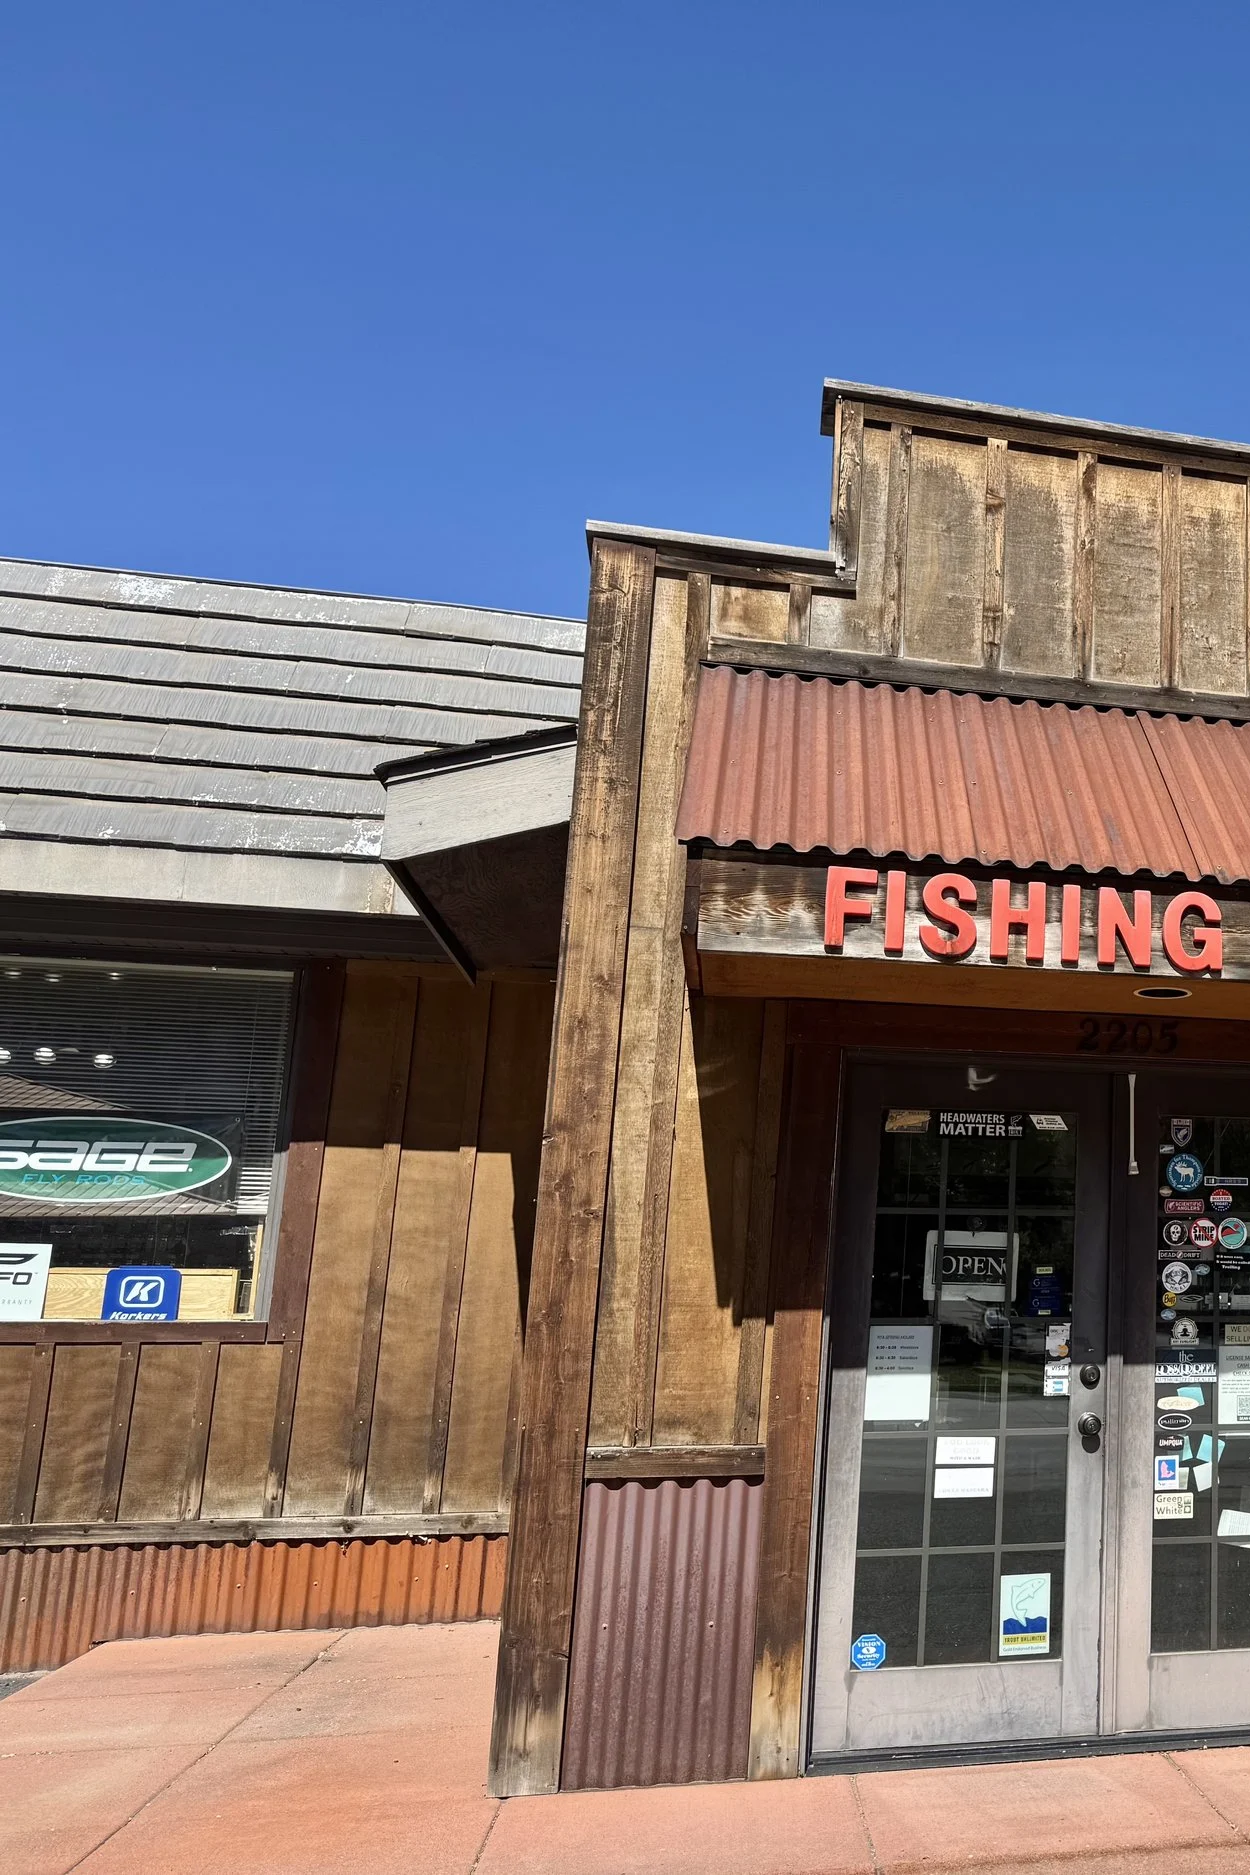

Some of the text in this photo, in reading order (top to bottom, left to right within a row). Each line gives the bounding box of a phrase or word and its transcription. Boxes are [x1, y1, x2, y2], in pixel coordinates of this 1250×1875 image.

[824, 866, 1222, 972] FISHING
[1076, 1016, 1179, 1054] 2205
[940, 1112, 1005, 1124] HEADWATERS
[939, 1123, 1006, 1136] MATTER
[21, 1173, 145, 1186] FLY RODS
[942, 1255, 1004, 1275] OPEN
[1159, 1439, 1183, 1447] UMPQUA
[1156, 1495, 1182, 1505] Green
[1156, 1507, 1183, 1515] White
